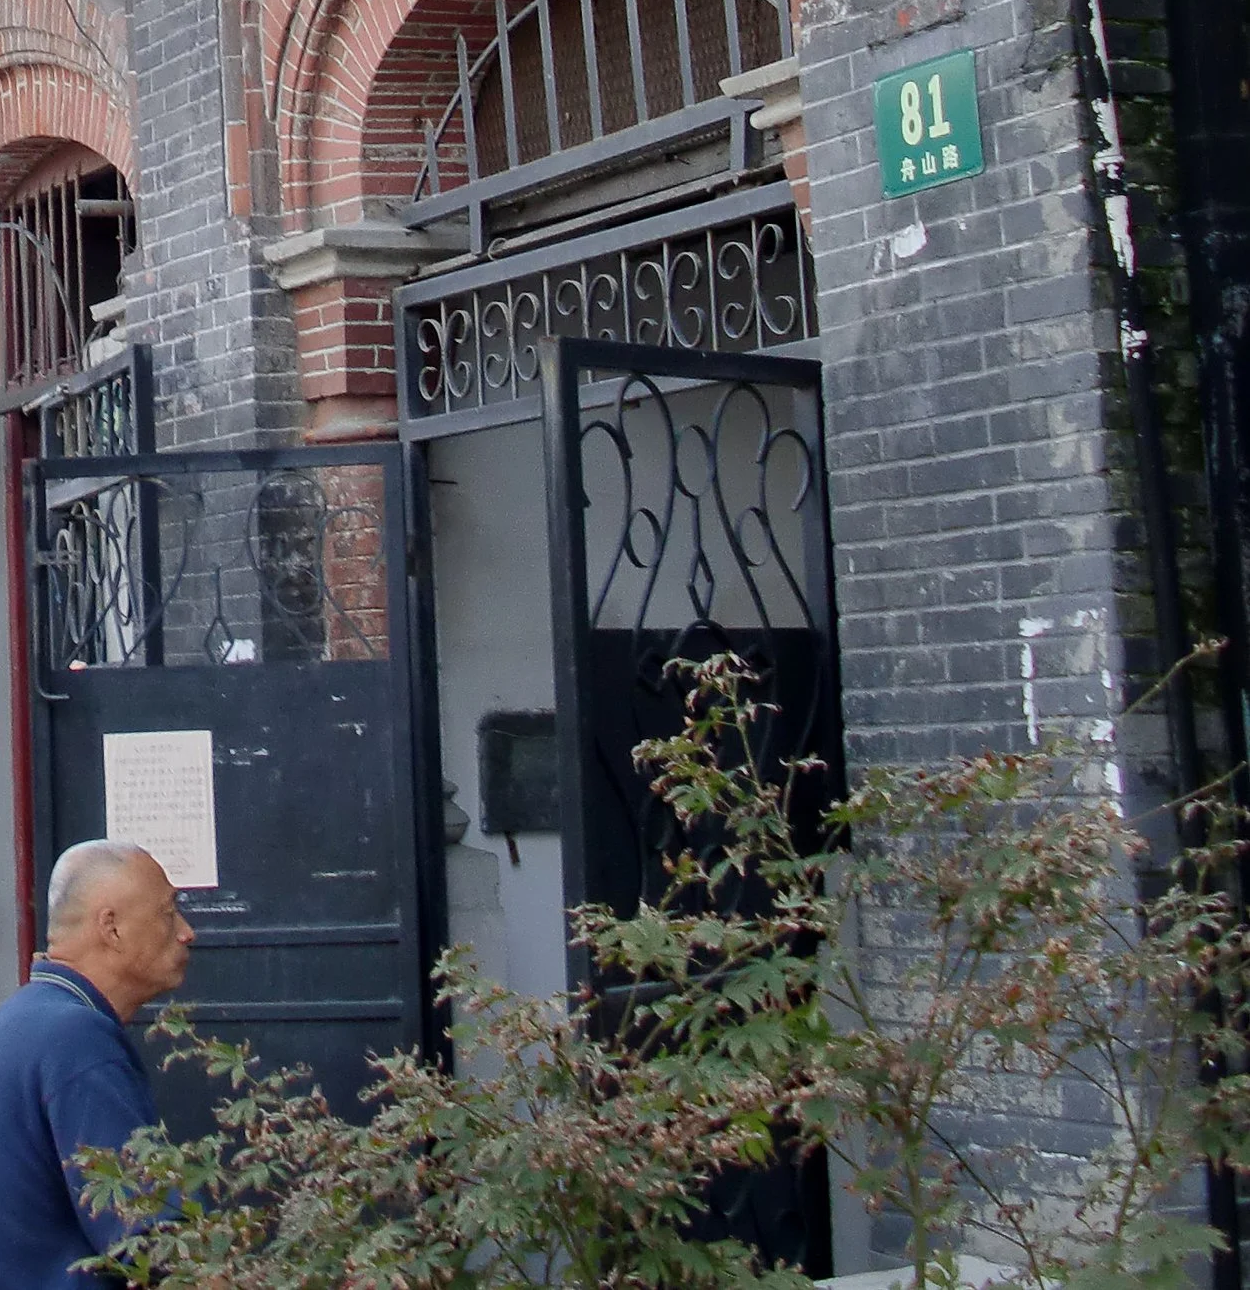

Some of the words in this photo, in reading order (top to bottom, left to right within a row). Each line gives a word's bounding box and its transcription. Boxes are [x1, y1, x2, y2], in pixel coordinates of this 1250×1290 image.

[901, 74, 951, 146] 81
[900, 144, 959, 183] 舟山路
